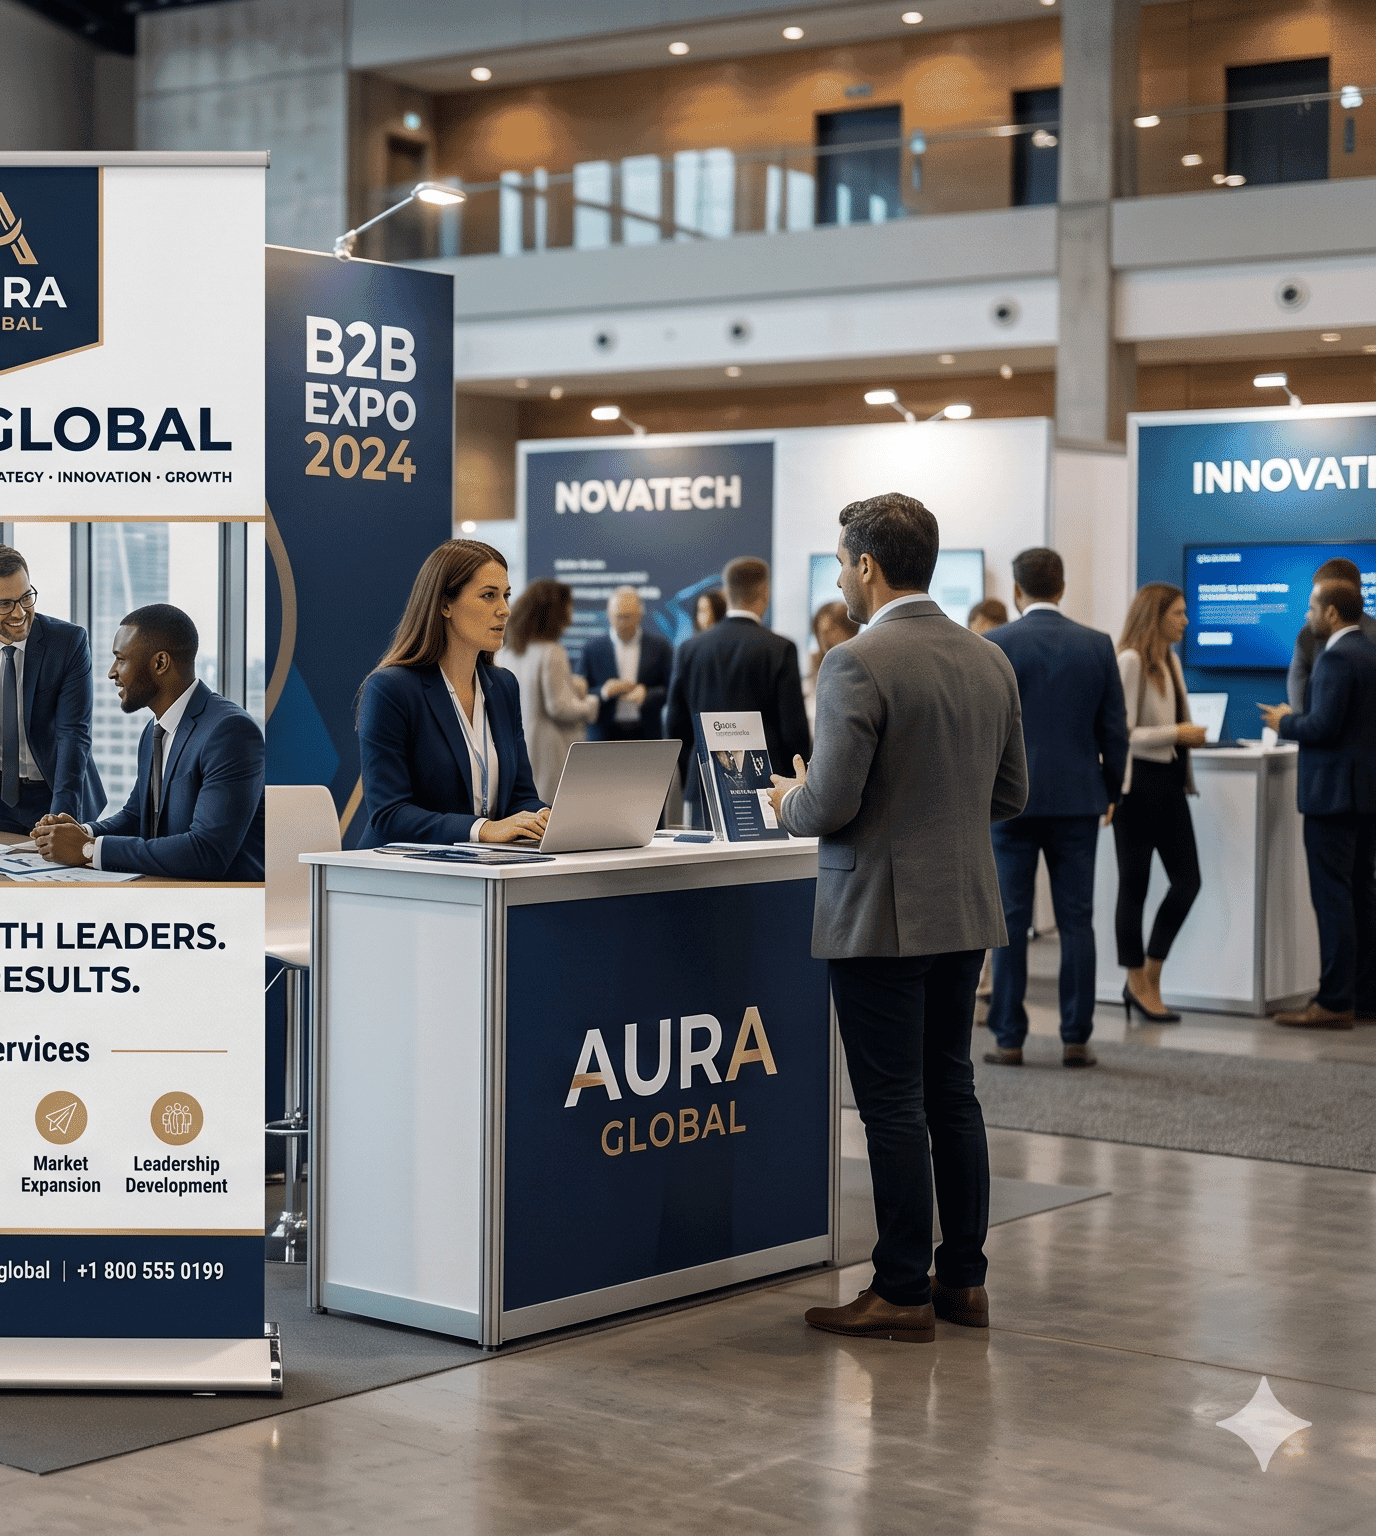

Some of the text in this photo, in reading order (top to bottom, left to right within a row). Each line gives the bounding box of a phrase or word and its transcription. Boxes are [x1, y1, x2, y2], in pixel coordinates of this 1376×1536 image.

[305, 315, 417, 383] B2B
[305, 381, 417, 432] EXPO
[304, 431, 417, 483] 2024
[57, 471, 152, 484] INNOVATION
[164, 471, 233, 484] GROWTH
[555, 475, 741, 514] NOVATECH
[56, 922, 226, 950] LEADERS.
[564, 1005, 778, 1108] AURA
[601, 1100, 746, 1157] GLOBAL
[33, 1154, 89, 1172] Market
[133, 1155, 220, 1176] Leadership
[21, 1176, 101, 1197] Expansion
[125, 1176, 228, 1197] Development
[77, 1261, 96, 1279] +1
[104, 1261, 137, 1280] 800
[142, 1261, 175, 1280] 555
[180, 1261, 224, 1280] 0199
